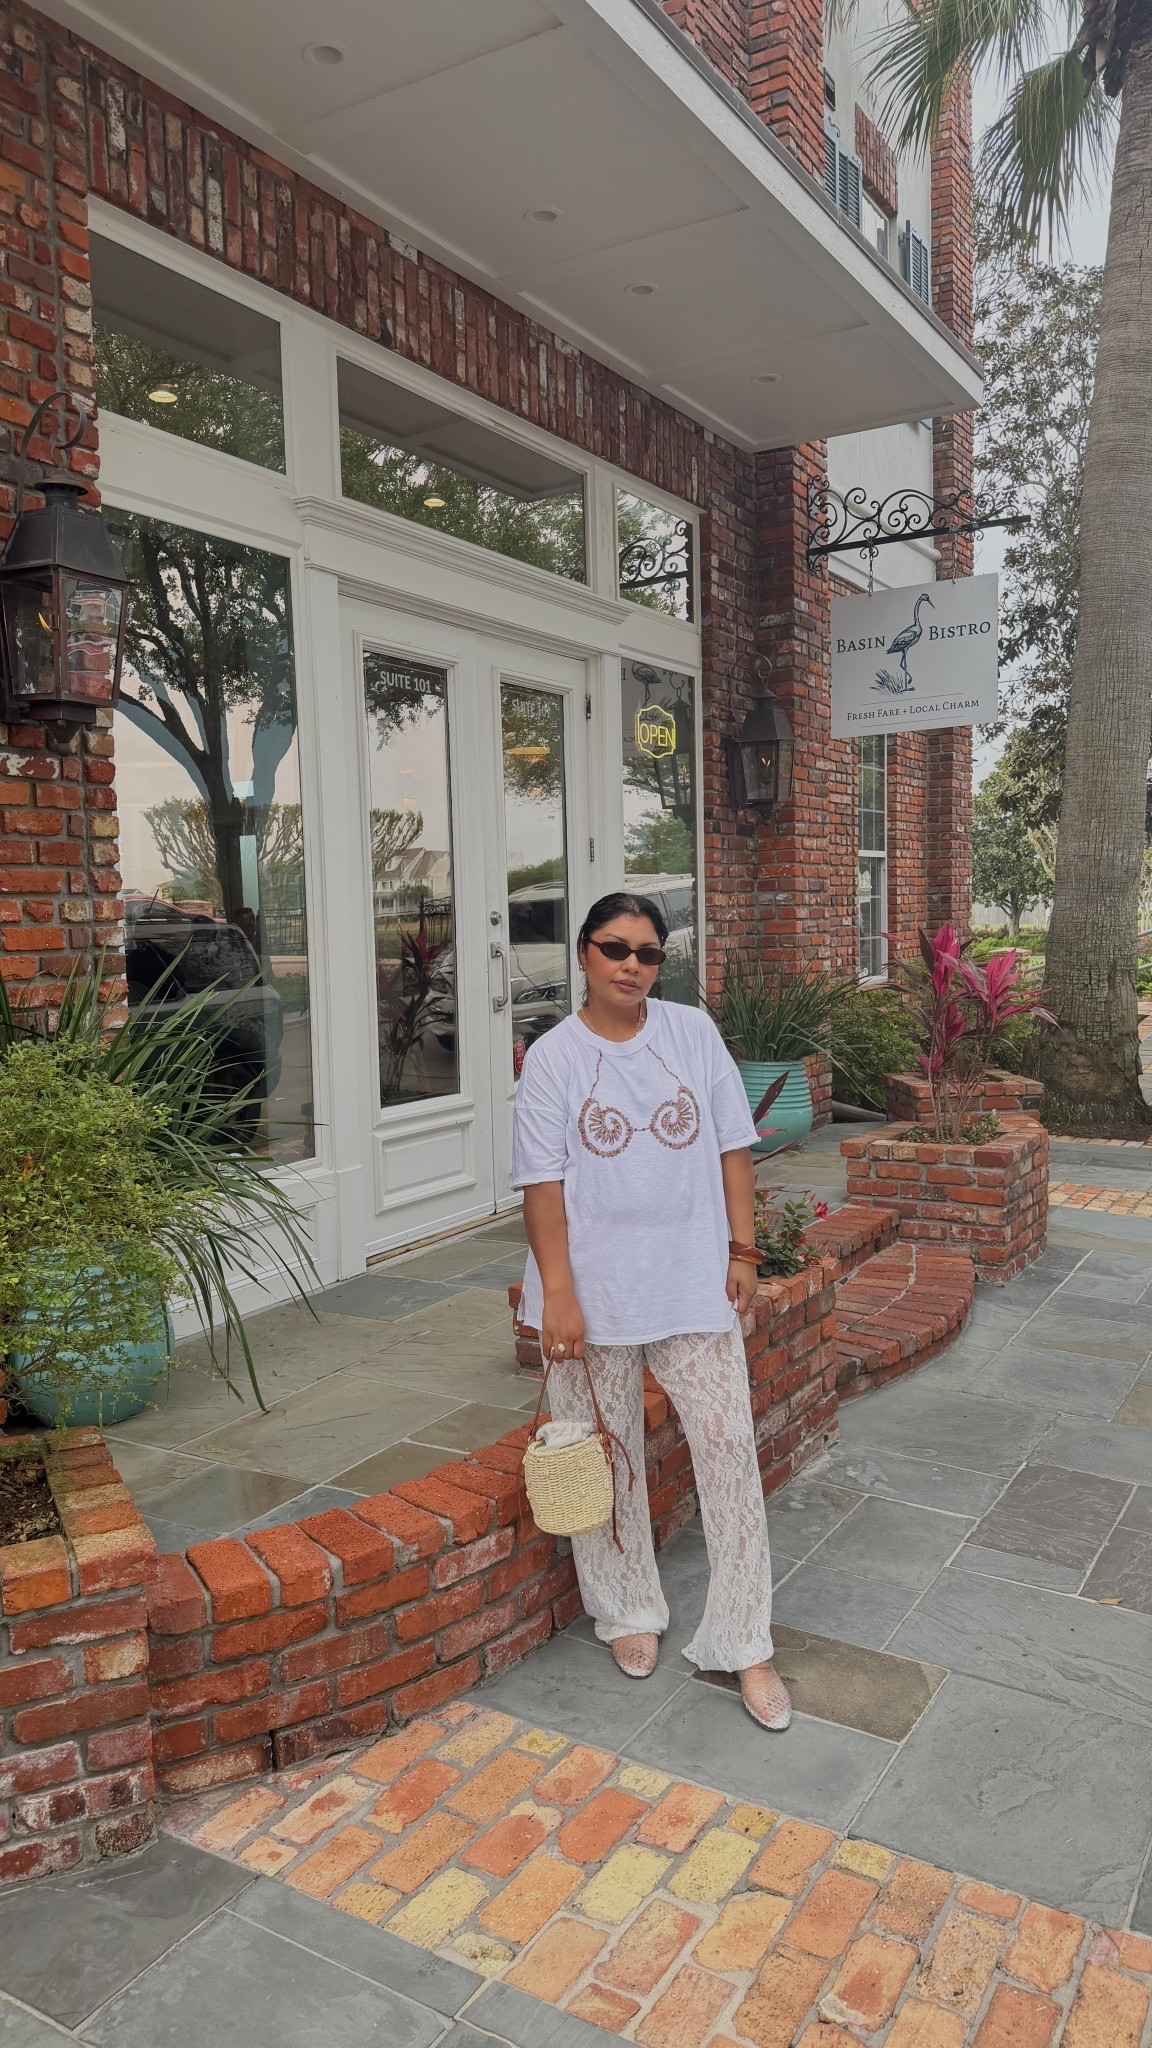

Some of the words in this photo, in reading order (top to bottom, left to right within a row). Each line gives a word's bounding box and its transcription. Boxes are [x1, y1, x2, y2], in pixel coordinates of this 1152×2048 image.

[836, 635, 886, 653] BASIN
[928, 621, 991, 641] BISTRO
[380, 670, 411, 690] SUITE
[413, 677, 431, 693] 101
[847, 712, 875, 720] FRESH
[877, 709, 900, 717] FARE
[909, 705, 940, 714] LOCAL
[942, 700, 979, 710] CHARM
[640, 722, 674, 747] OPEN
